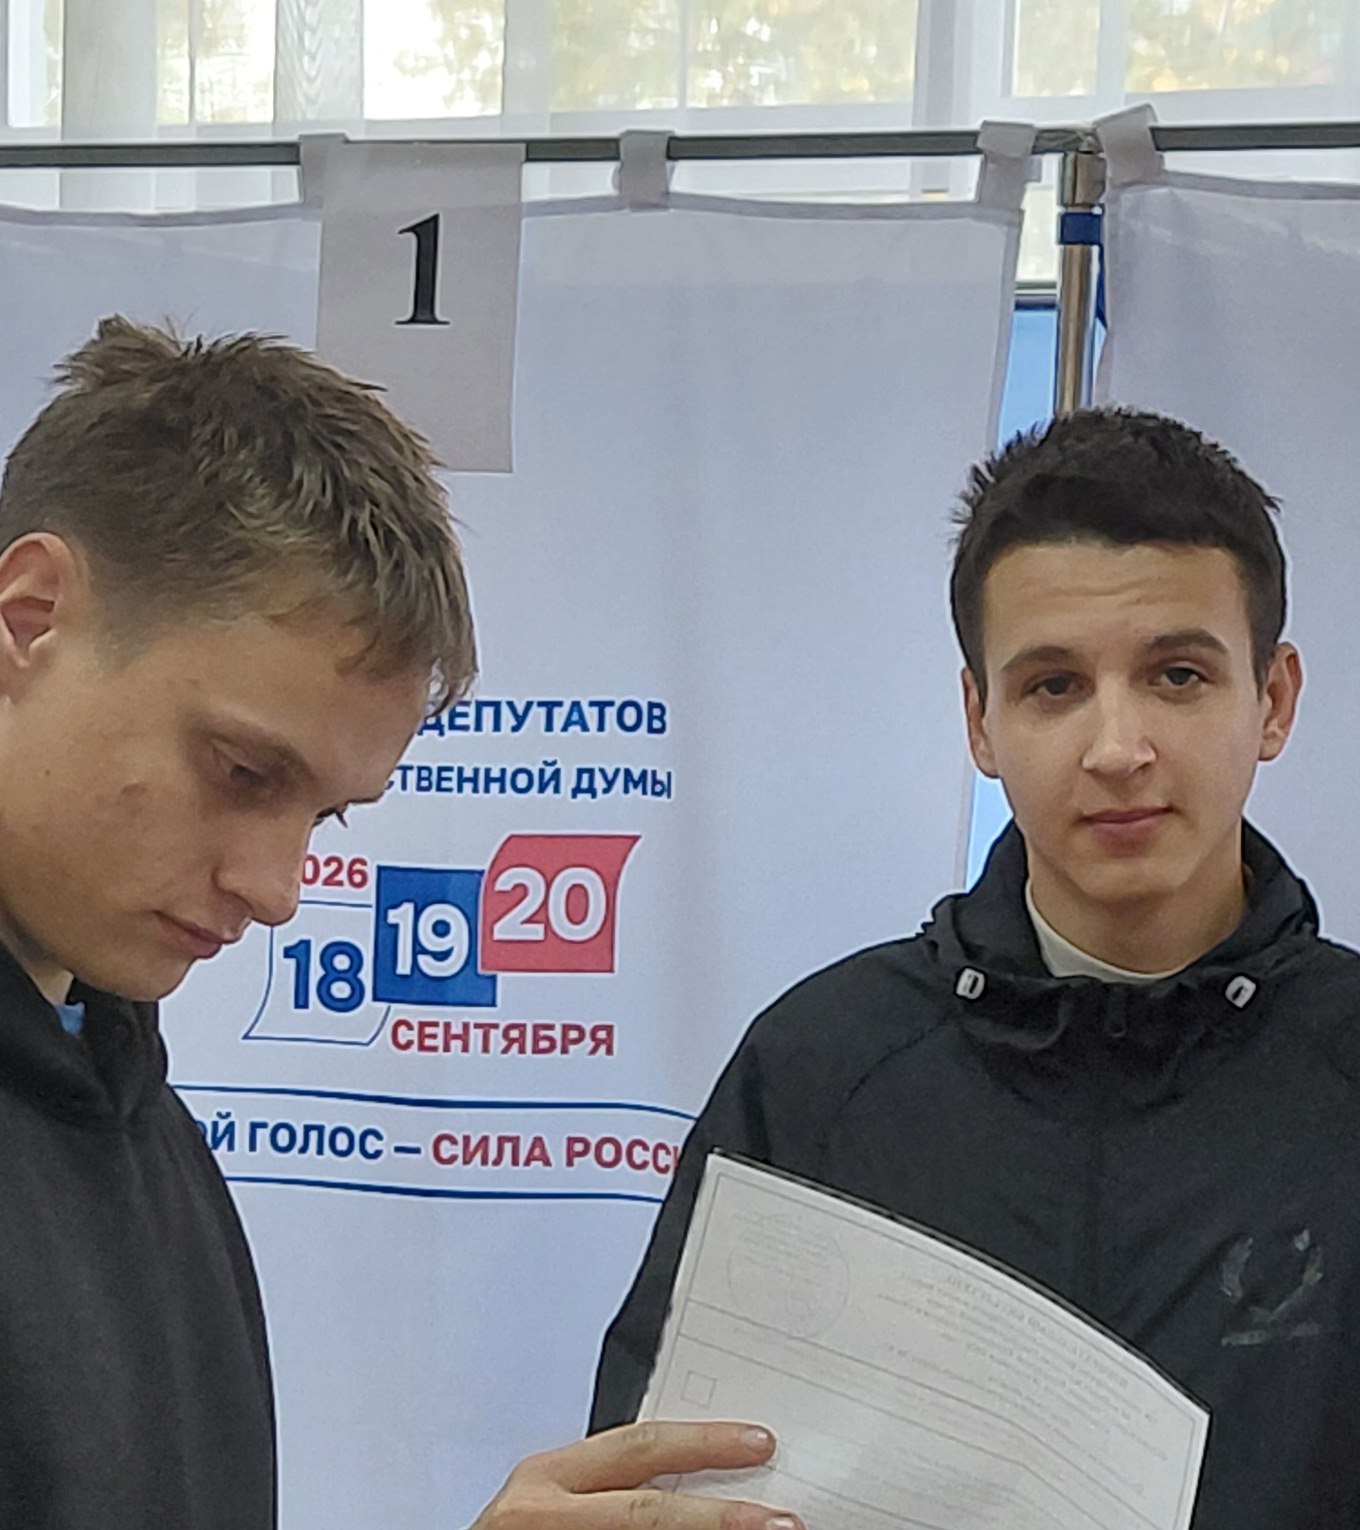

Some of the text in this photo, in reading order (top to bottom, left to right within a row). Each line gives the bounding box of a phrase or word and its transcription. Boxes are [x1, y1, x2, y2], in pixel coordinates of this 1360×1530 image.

[394, 212, 451, 326] 1
[383, 758, 672, 800] ТВЕННОЙ ДУМЫ
[300, 855, 369, 889] 026
[283, 865, 608, 1014] 18 19 20
[391, 1018, 615, 1056] СЕНТЯБРЯ
[249, 1120, 384, 1160] ГОЛОС
[432, 1132, 553, 1168] СИЛА
